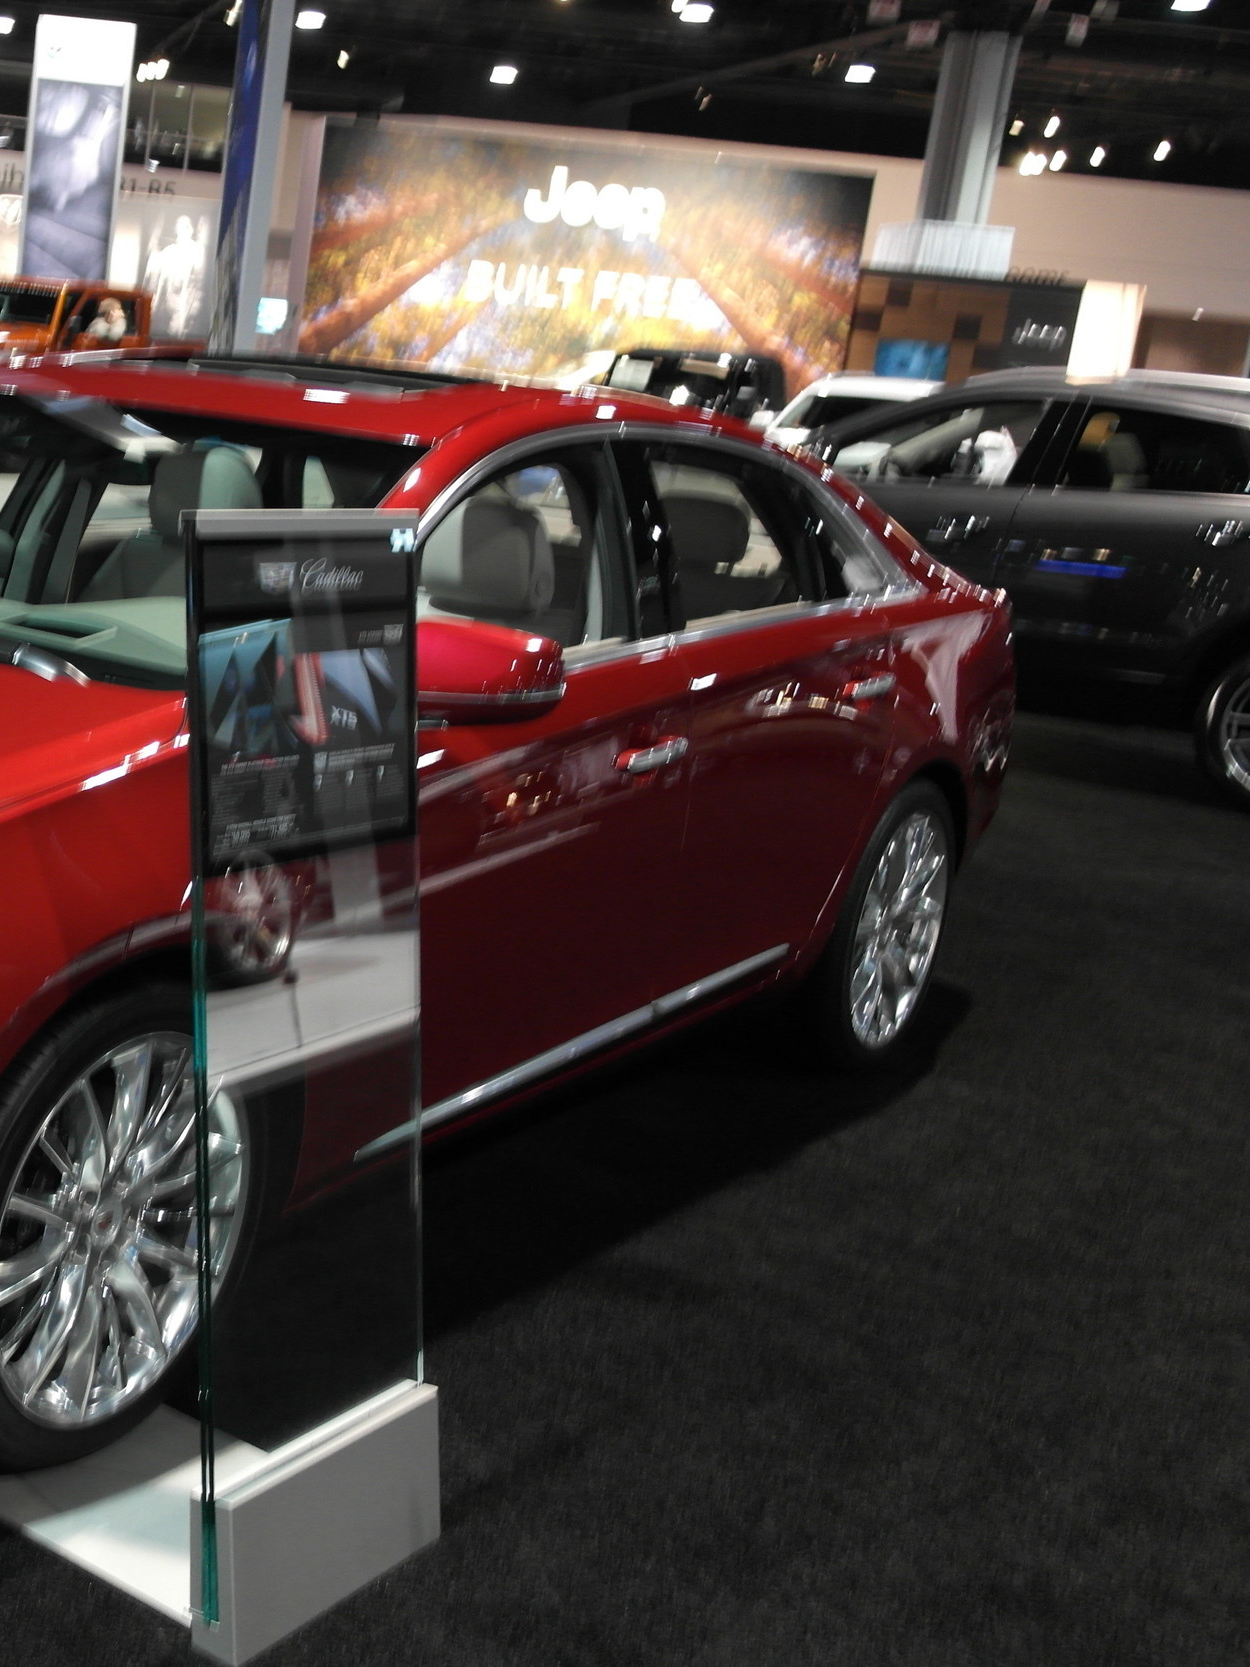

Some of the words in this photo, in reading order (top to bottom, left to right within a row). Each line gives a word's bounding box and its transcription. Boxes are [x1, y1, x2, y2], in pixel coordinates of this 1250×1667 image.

[524, 165, 666, 241] Jeep
[467, 259, 584, 310] BUILT
[1012, 318, 1067, 351] Jeep
[301, 557, 363, 594] Cadillac
